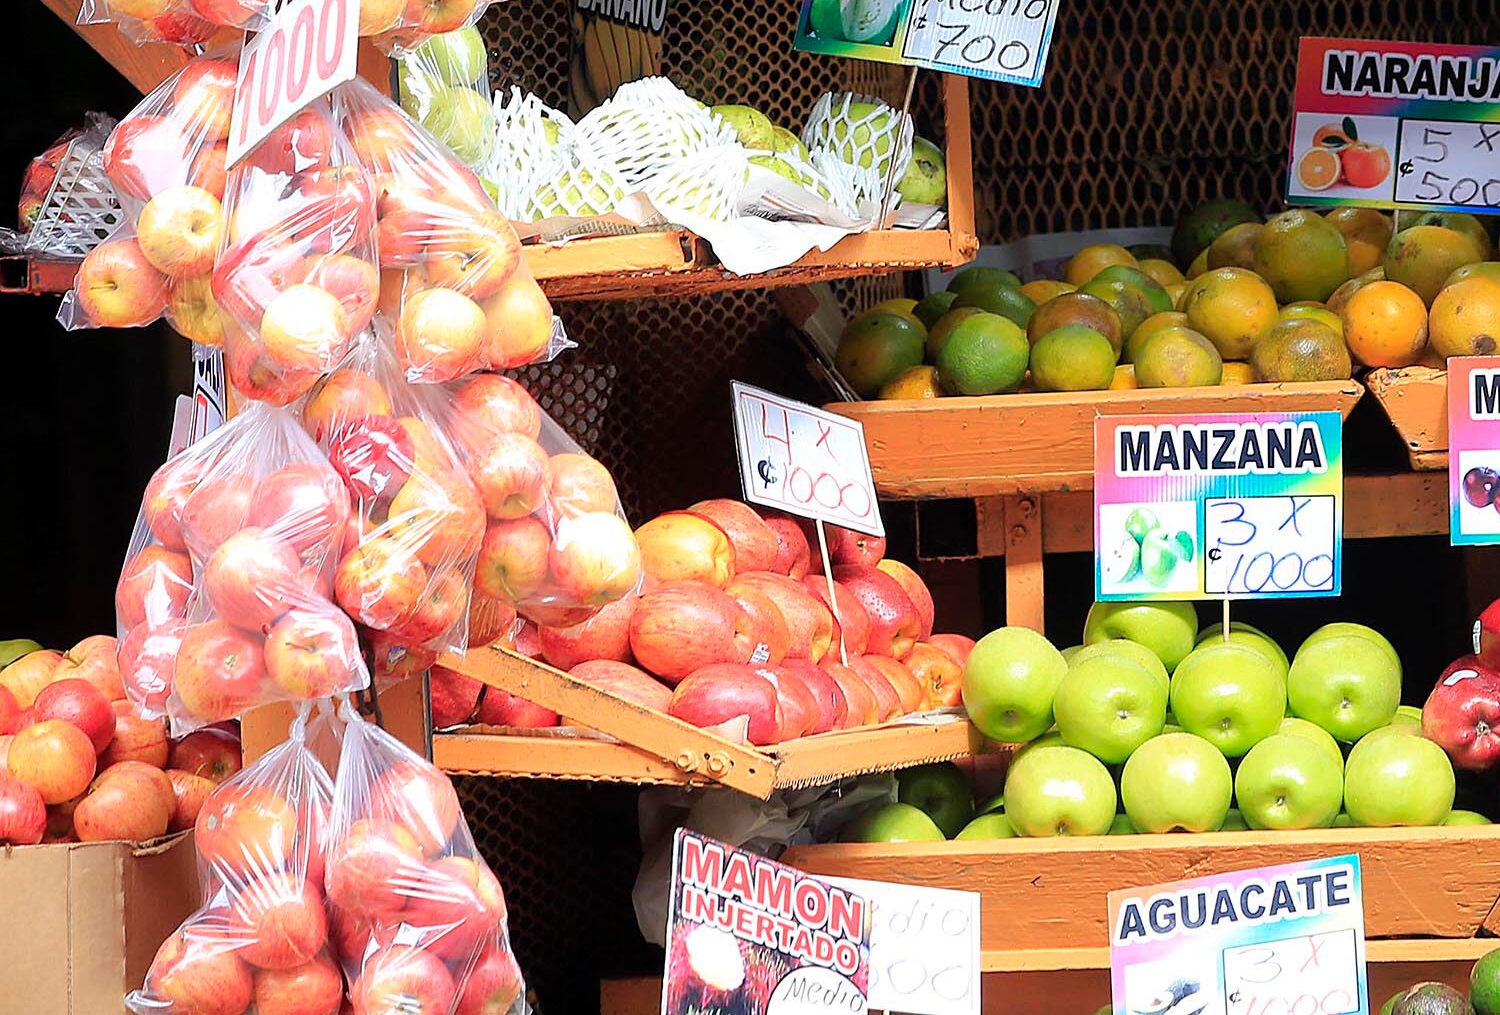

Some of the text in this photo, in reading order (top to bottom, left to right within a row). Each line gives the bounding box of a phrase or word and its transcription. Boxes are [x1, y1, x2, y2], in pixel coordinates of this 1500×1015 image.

[936, 22, 1031, 70] 700
[1414, 128, 1453, 163] 5
[1120, 428, 1322, 472] MANZANA
[782, 462, 871, 518] 1000
[1210, 501, 1256, 546] 3
[1226, 551, 1334, 594] 1000
[685, 841, 862, 938] MAMON
[1119, 870, 1350, 940] AGUACATE
[684, 889, 857, 975] INJERTADO
[1237, 948, 1283, 984] 3
